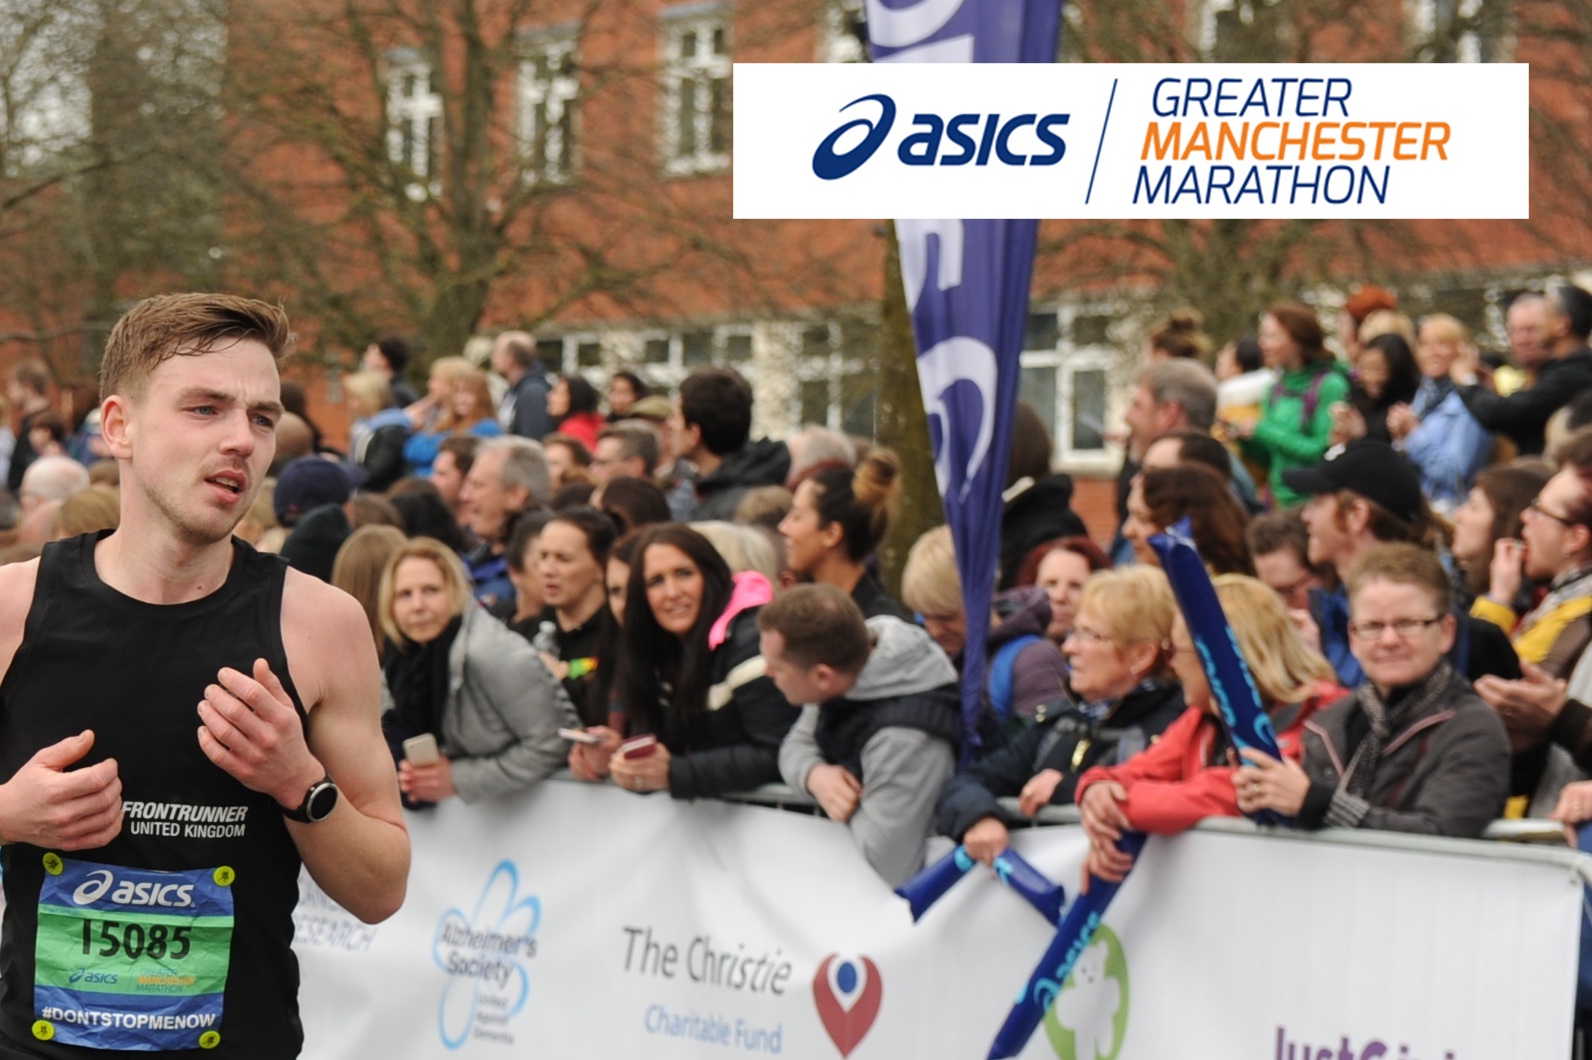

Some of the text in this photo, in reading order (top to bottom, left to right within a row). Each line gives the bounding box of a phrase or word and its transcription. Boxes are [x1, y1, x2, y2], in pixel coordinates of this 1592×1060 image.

[121, 801, 248, 822] FRONTRUNNER
[130, 821, 246, 838] UNITED KINGDOM
[81, 919, 192, 960] 15085
[442, 923, 538, 959] Alzheimer's
[140, 968, 177, 976] GREATER
[447, 952, 515, 990] Society
[622, 926, 793, 996] The Christie
[135, 984, 183, 993] MARATHON
[138, 975, 196, 985] MANCHESTER
[42, 1006, 215, 1030] #DONTSTOPMENOW
[644, 1003, 783, 1054] Charitable Fund
